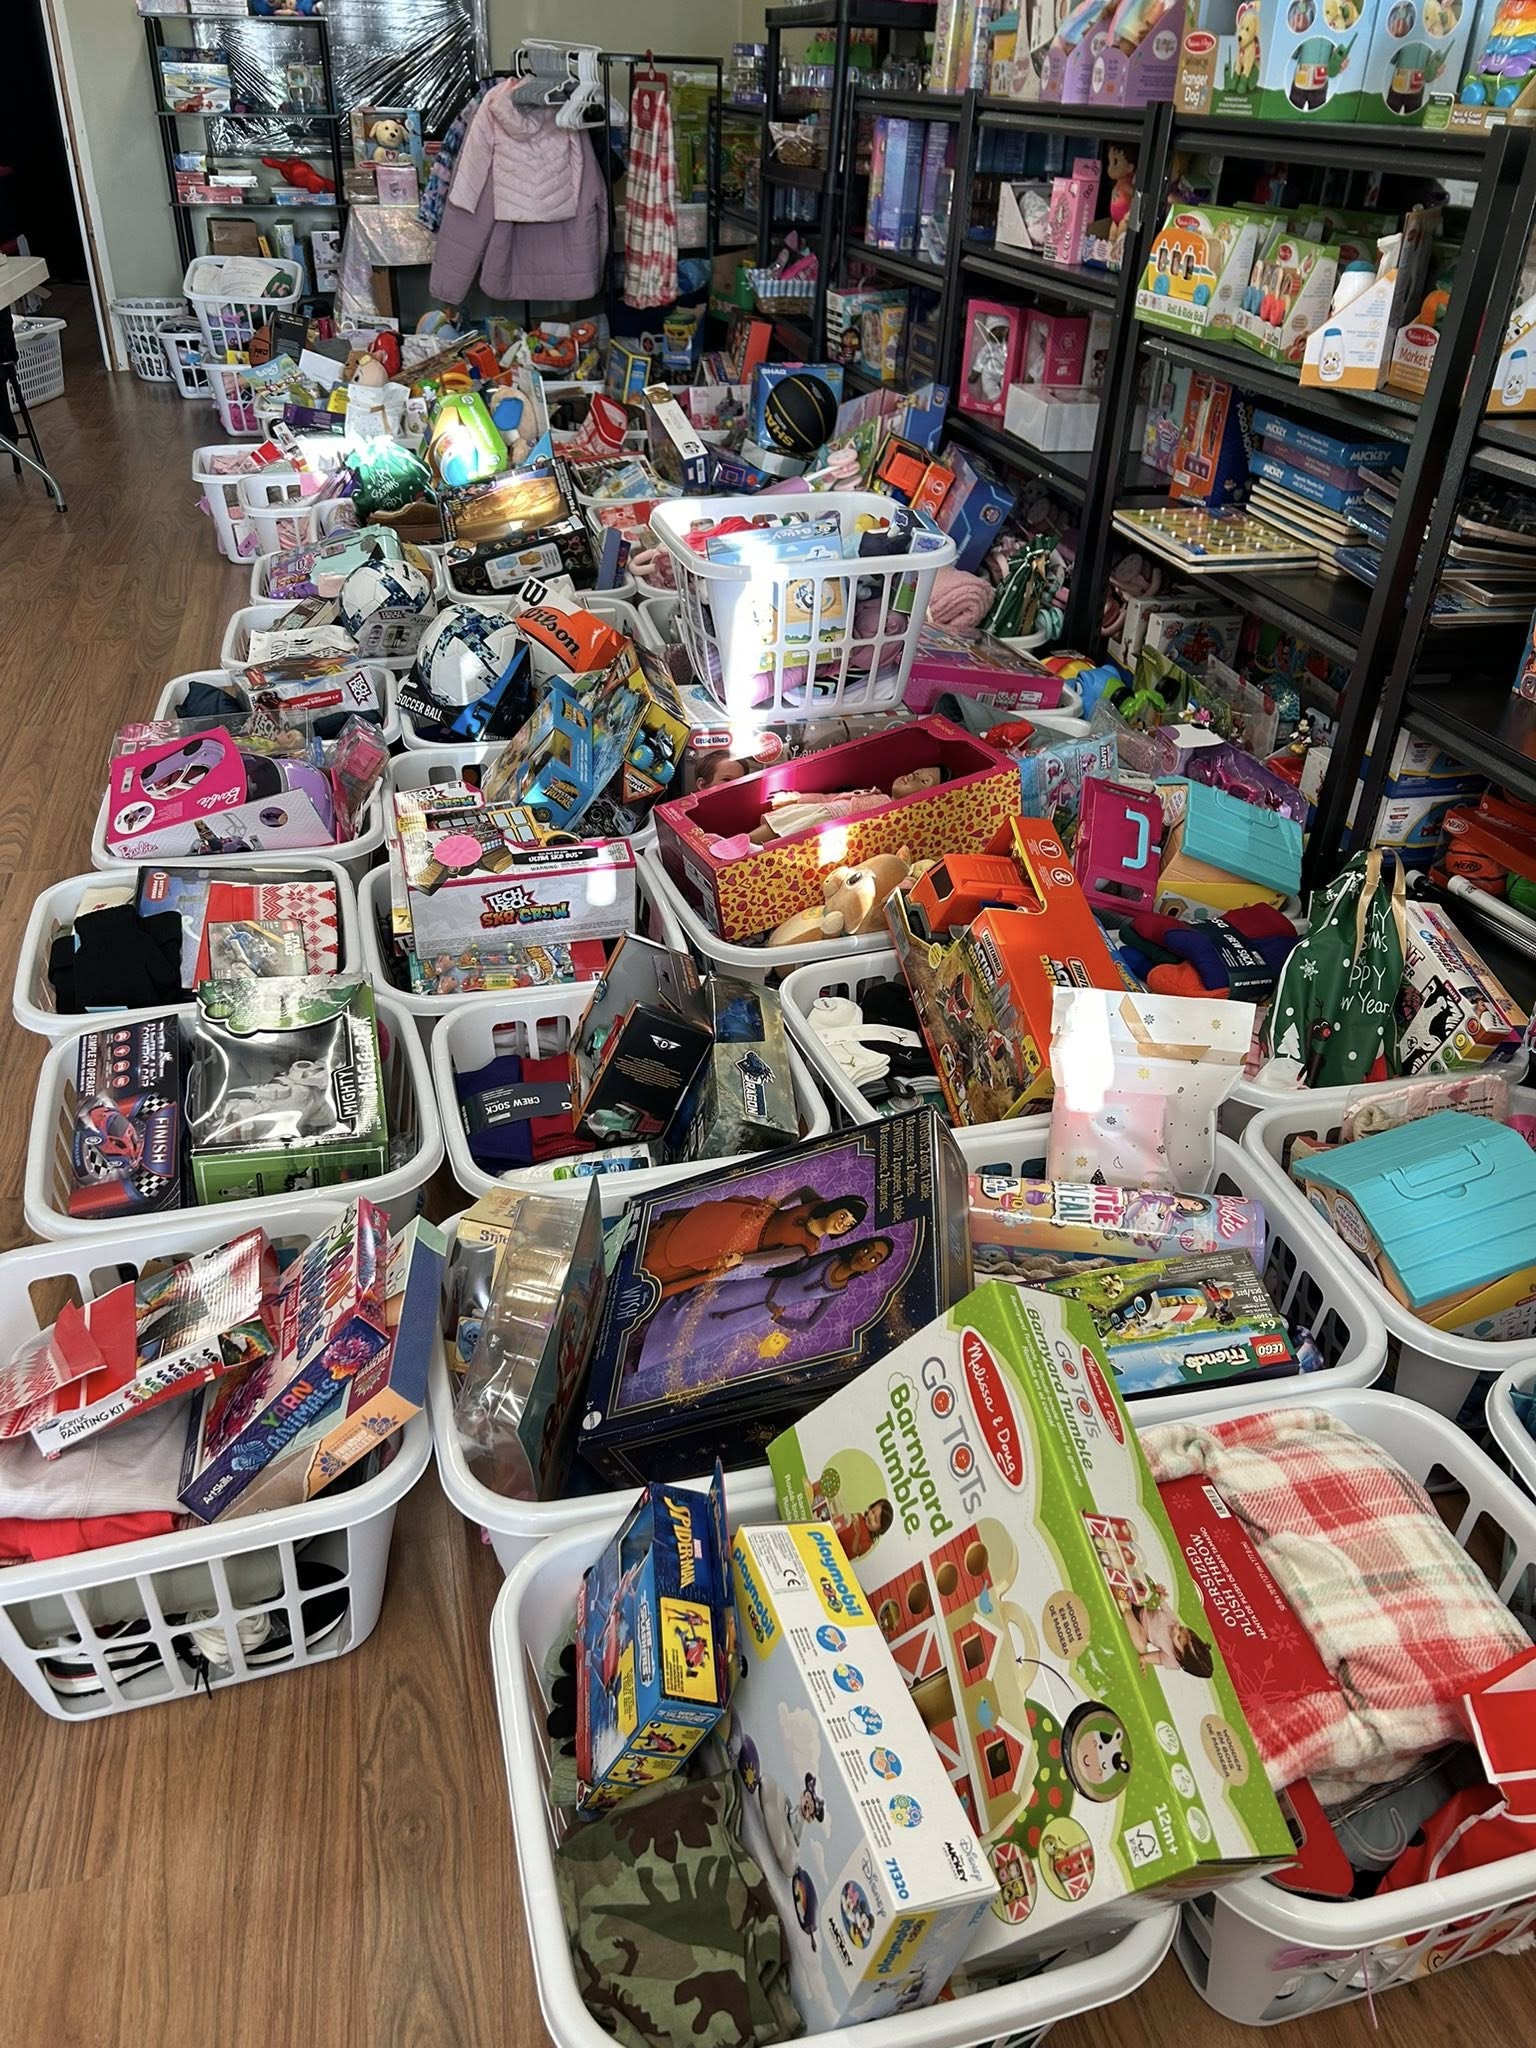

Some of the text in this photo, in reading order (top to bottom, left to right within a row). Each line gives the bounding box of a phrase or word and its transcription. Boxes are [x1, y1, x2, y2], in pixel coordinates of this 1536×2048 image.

[1182, 70, 1208, 89] Ranger
[1184, 87, 1200, 106] Dog
[1400, 347, 1428, 367] Market
[1345, 495, 1366, 506] MIC
[519, 607, 580, 657] Wilson
[350, 682, 367, 703] DECK
[356, 674, 371, 695] TECH
[396, 694, 443, 722] SOCCER BALL
[693, 734, 730, 746] little tikes
[197, 787, 241, 811] Barbie
[543, 787, 572, 808] TRUCKS
[118, 841, 158, 859] Barbie
[528, 854, 549, 864] ULTRA
[486, 886, 524, 907] TECH
[493, 894, 531, 913] DECK
[480, 911, 518, 930] SK8
[519, 902, 571, 923] CREW
[282, 932, 293, 957] WARS
[291, 932, 302, 955] STAR
[984, 932, 1002, 973] MATCHBOX
[1237, 949, 1256, 966] SOCK
[1426, 941, 1456, 974] NUMBER
[968, 943, 991, 994] DRIVERS
[974, 941, 996, 990] ACTION
[1050, 960, 1073, 987] ACT
[1358, 991, 1391, 1015] Year
[85, 1034, 98, 1097] SIMPLE TO OPERATE
[339, 1071, 359, 1116] MIGHTY
[485, 1096, 541, 1115] CREW SOCK
[880, 1123, 891, 1133] 10
[906, 1114, 916, 1124] 10
[151, 1117, 169, 1163] FINISH
[1055, 1184, 1091, 1223] EVEAL
[1216, 1193, 1250, 1240] Barbie
[616, 1284, 643, 1321] WISH
[1253, 1294, 1266, 1303] 170
[1259, 1319, 1277, 1330] 6+
[1055, 1340, 1078, 1380] GO
[1185, 1345, 1251, 1375] Friends
[1257, 1342, 1284, 1356] LEGO
[921, 1356, 955, 1420] GO
[1027, 1307, 1094, 1470] Barnyard Tumble
[1086, 1353, 1105, 1399] Melissa
[261, 1379, 314, 1427] YARN
[267, 1378, 339, 1449] ANIMALS
[967, 1340, 1017, 1477] Melissa & Doug
[58, 1413, 88, 1432] ACRYLIC
[60, 1402, 126, 1440] PAINTING KIT
[875, 1410, 920, 1535] Tumble
[890, 1382, 953, 1538] Barnyard
[202, 1474, 234, 1504] ArtSkills
[663, 1495, 696, 1589] SPIDER-MAN
[807, 1531, 864, 1617] playmobil
[1217, 1554, 1230, 1574] GRAN
[1225, 1573, 1236, 1584] DE
[733, 1547, 776, 1640] playmobil
[1185, 1546, 1237, 1628] OVERSIZED
[1189, 1533, 1257, 1638] PLUSH THROW
[1231, 1582, 1249, 1606] PLUSH
[1058, 1607, 1075, 1644] EN BOIS
[1065, 1600, 1084, 1641] WOODEN
[1243, 1604, 1255, 1616] DE
[1250, 1613, 1269, 1640] MANTA
[1049, 1604, 1070, 1656] DE MADERA
[1205, 1722, 1230, 1778] DE MADERA
[1216, 1730, 1235, 1770] EN BOIS
[1222, 1728, 1243, 1772] WOODEN
[1154, 1803, 1179, 1856] 12m+
[944, 1840, 969, 1882] MICKEY
[885, 1857, 911, 1901] 71320
[828, 1917, 854, 1967] MICKEY
